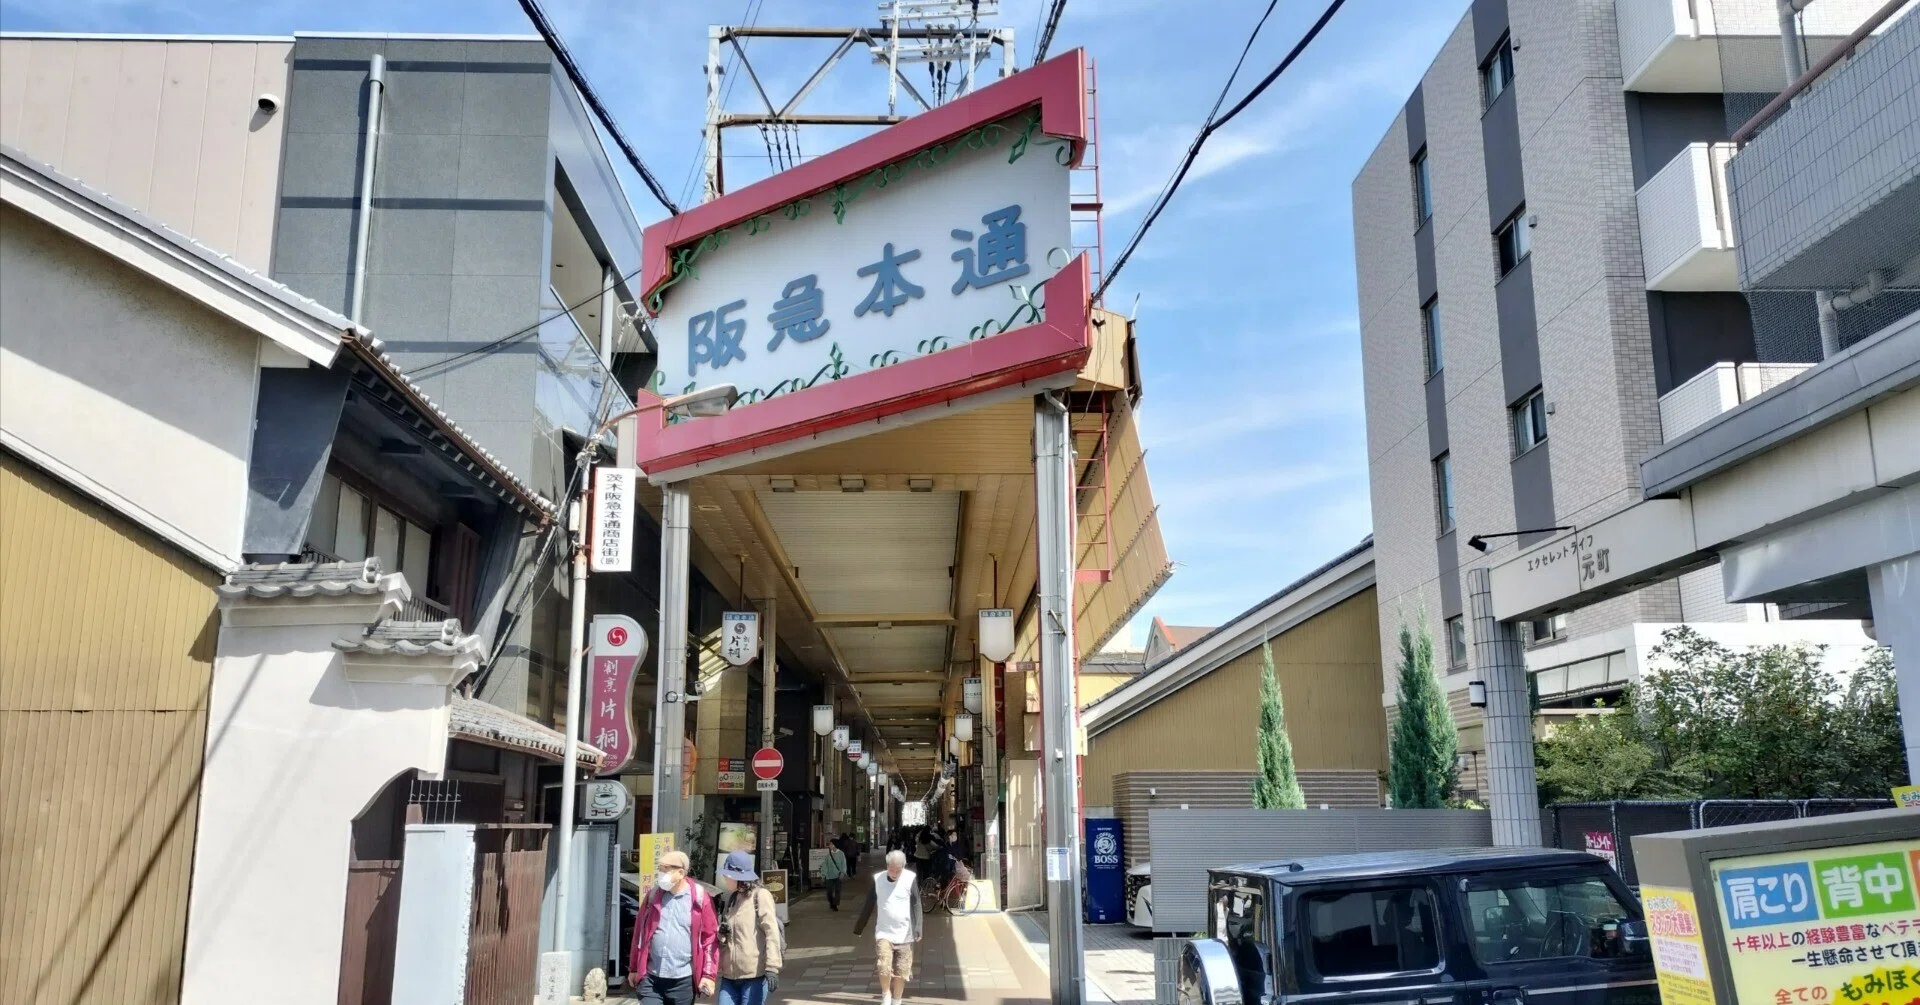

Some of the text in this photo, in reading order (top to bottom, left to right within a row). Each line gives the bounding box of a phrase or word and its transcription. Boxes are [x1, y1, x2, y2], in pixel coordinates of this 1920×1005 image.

[688, 204, 1030, 377] 阪急本通
[1527, 534, 1594, 571] エクセレントライフ
[1581, 548, 1609, 581] 元町
[591, 809, 619, 817] コーヒー
[1094, 855, 1118, 864] BOSS
[1726, 872, 1808, 920] 肩こり
[1821, 862, 1904, 910] 背中
